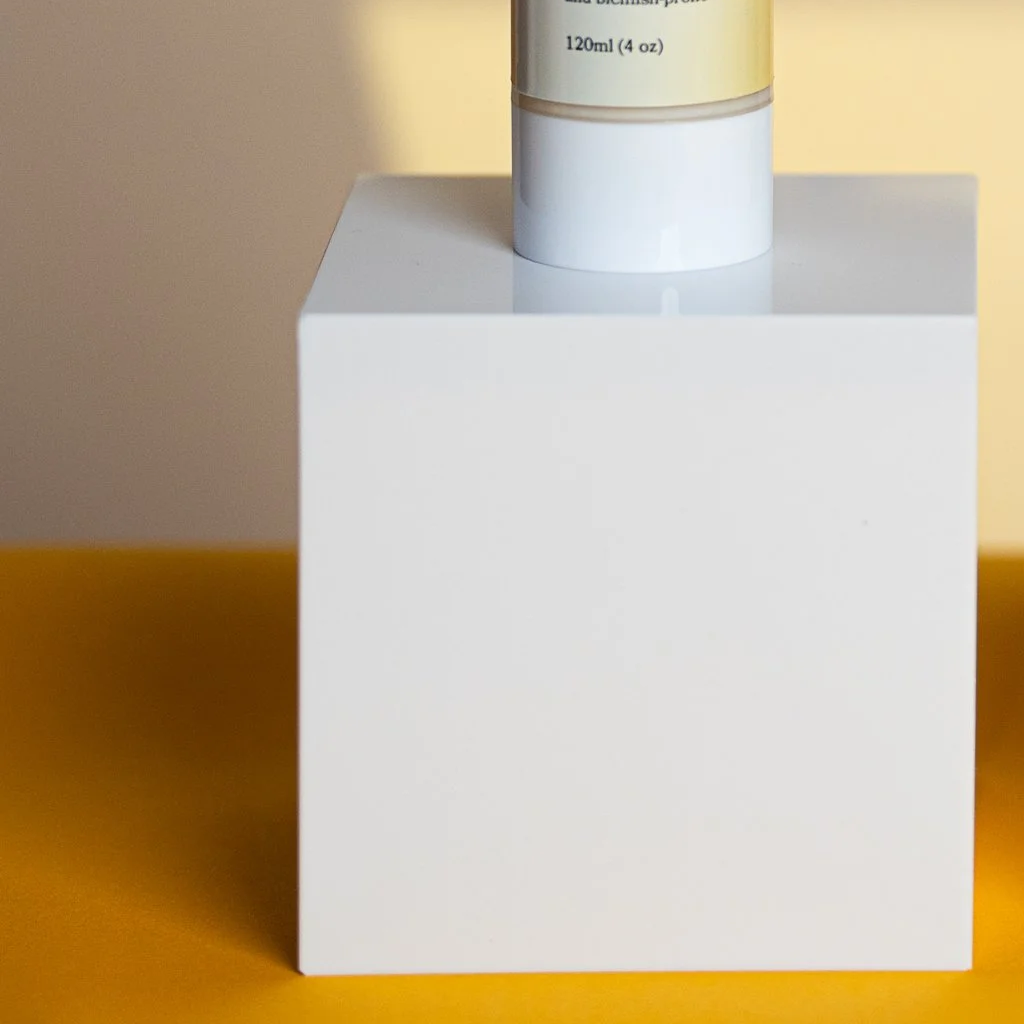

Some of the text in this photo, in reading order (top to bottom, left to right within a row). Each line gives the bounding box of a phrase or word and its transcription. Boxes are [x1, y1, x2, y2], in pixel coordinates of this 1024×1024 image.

[566, 36, 664, 56] 120ml (4 oz)
